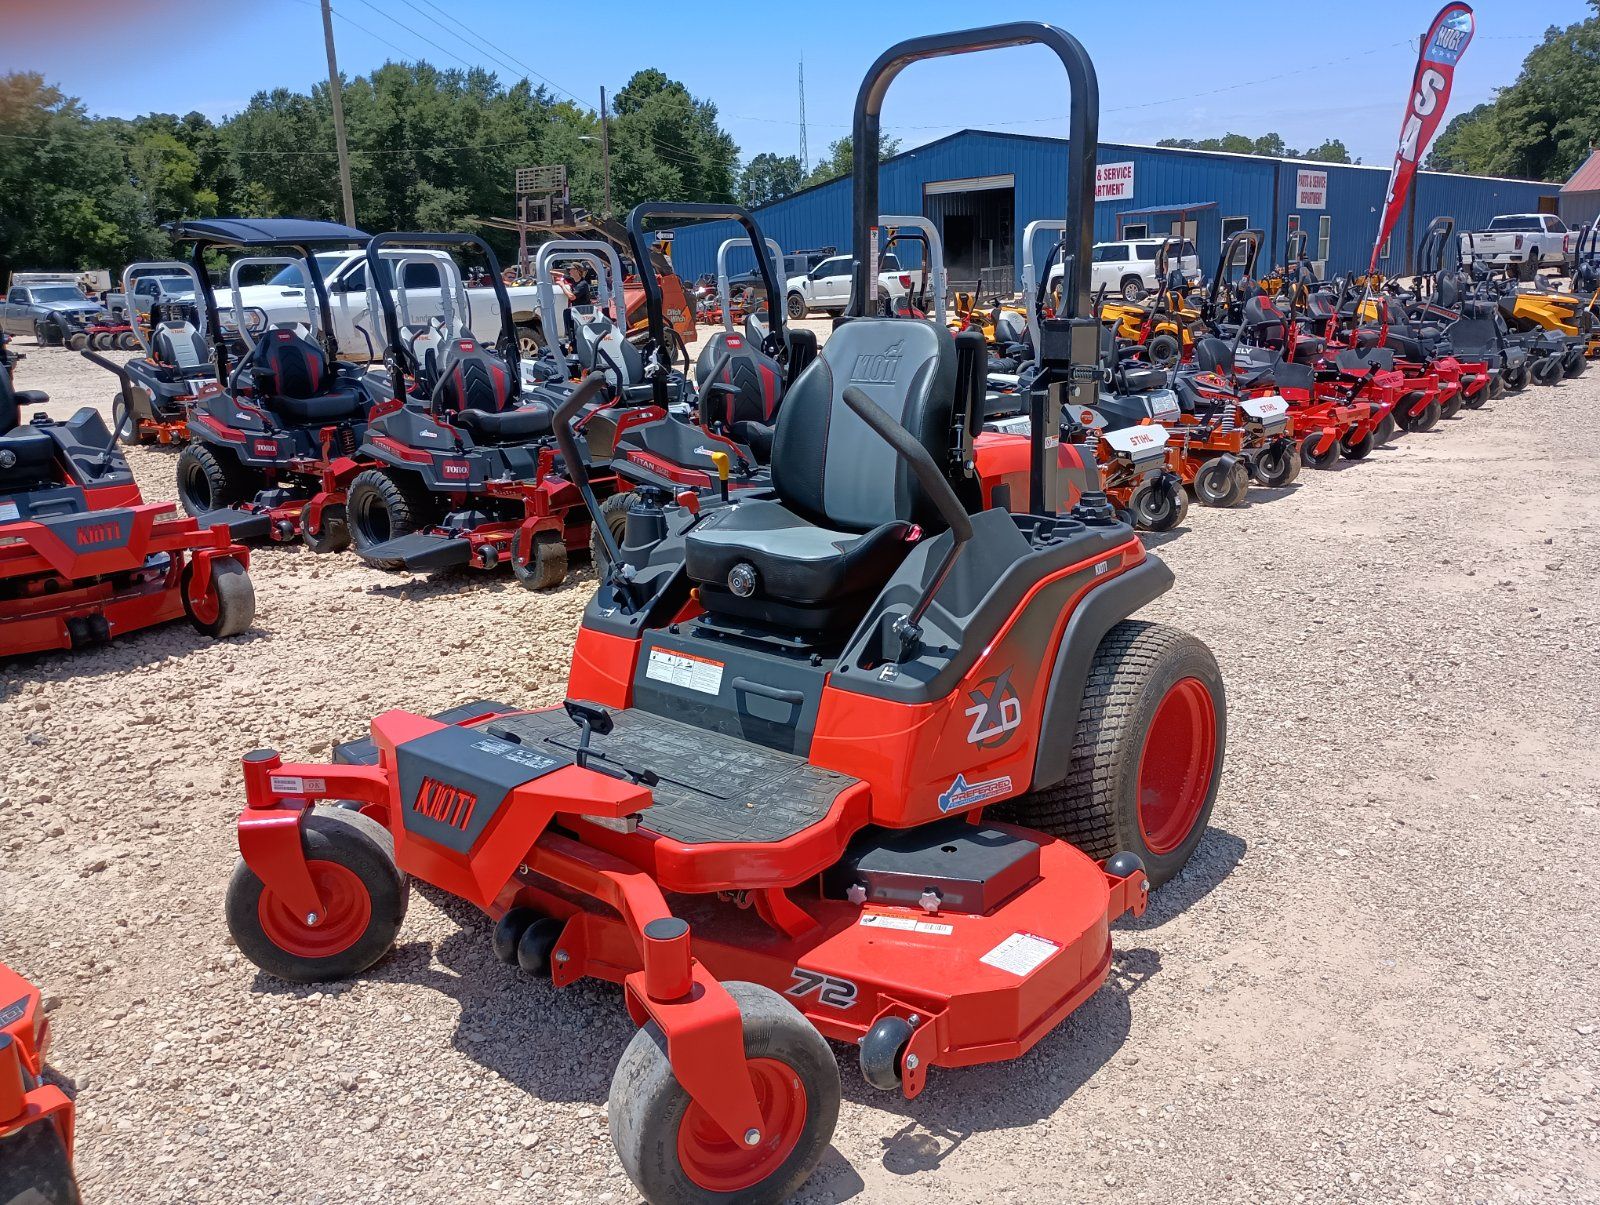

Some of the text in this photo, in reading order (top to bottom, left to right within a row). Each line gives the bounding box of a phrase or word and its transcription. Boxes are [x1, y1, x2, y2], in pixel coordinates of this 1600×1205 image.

[1436, 26, 1466, 51] HUGE
[1096, 166, 1132, 181] & SERVICE
[1259, 404, 1279, 413] STIHL
[1129, 433, 1154, 446] STIHL
[256, 444, 276, 452] TORO
[445, 465, 469, 475] TORO
[632, 455, 655, 470] TITAN
[77, 522, 120, 545] KIOTI
[952, 778, 1011, 803] PREFERRED
[413, 776, 478, 832] KIOTI
[784, 967, 859, 1009] 72
